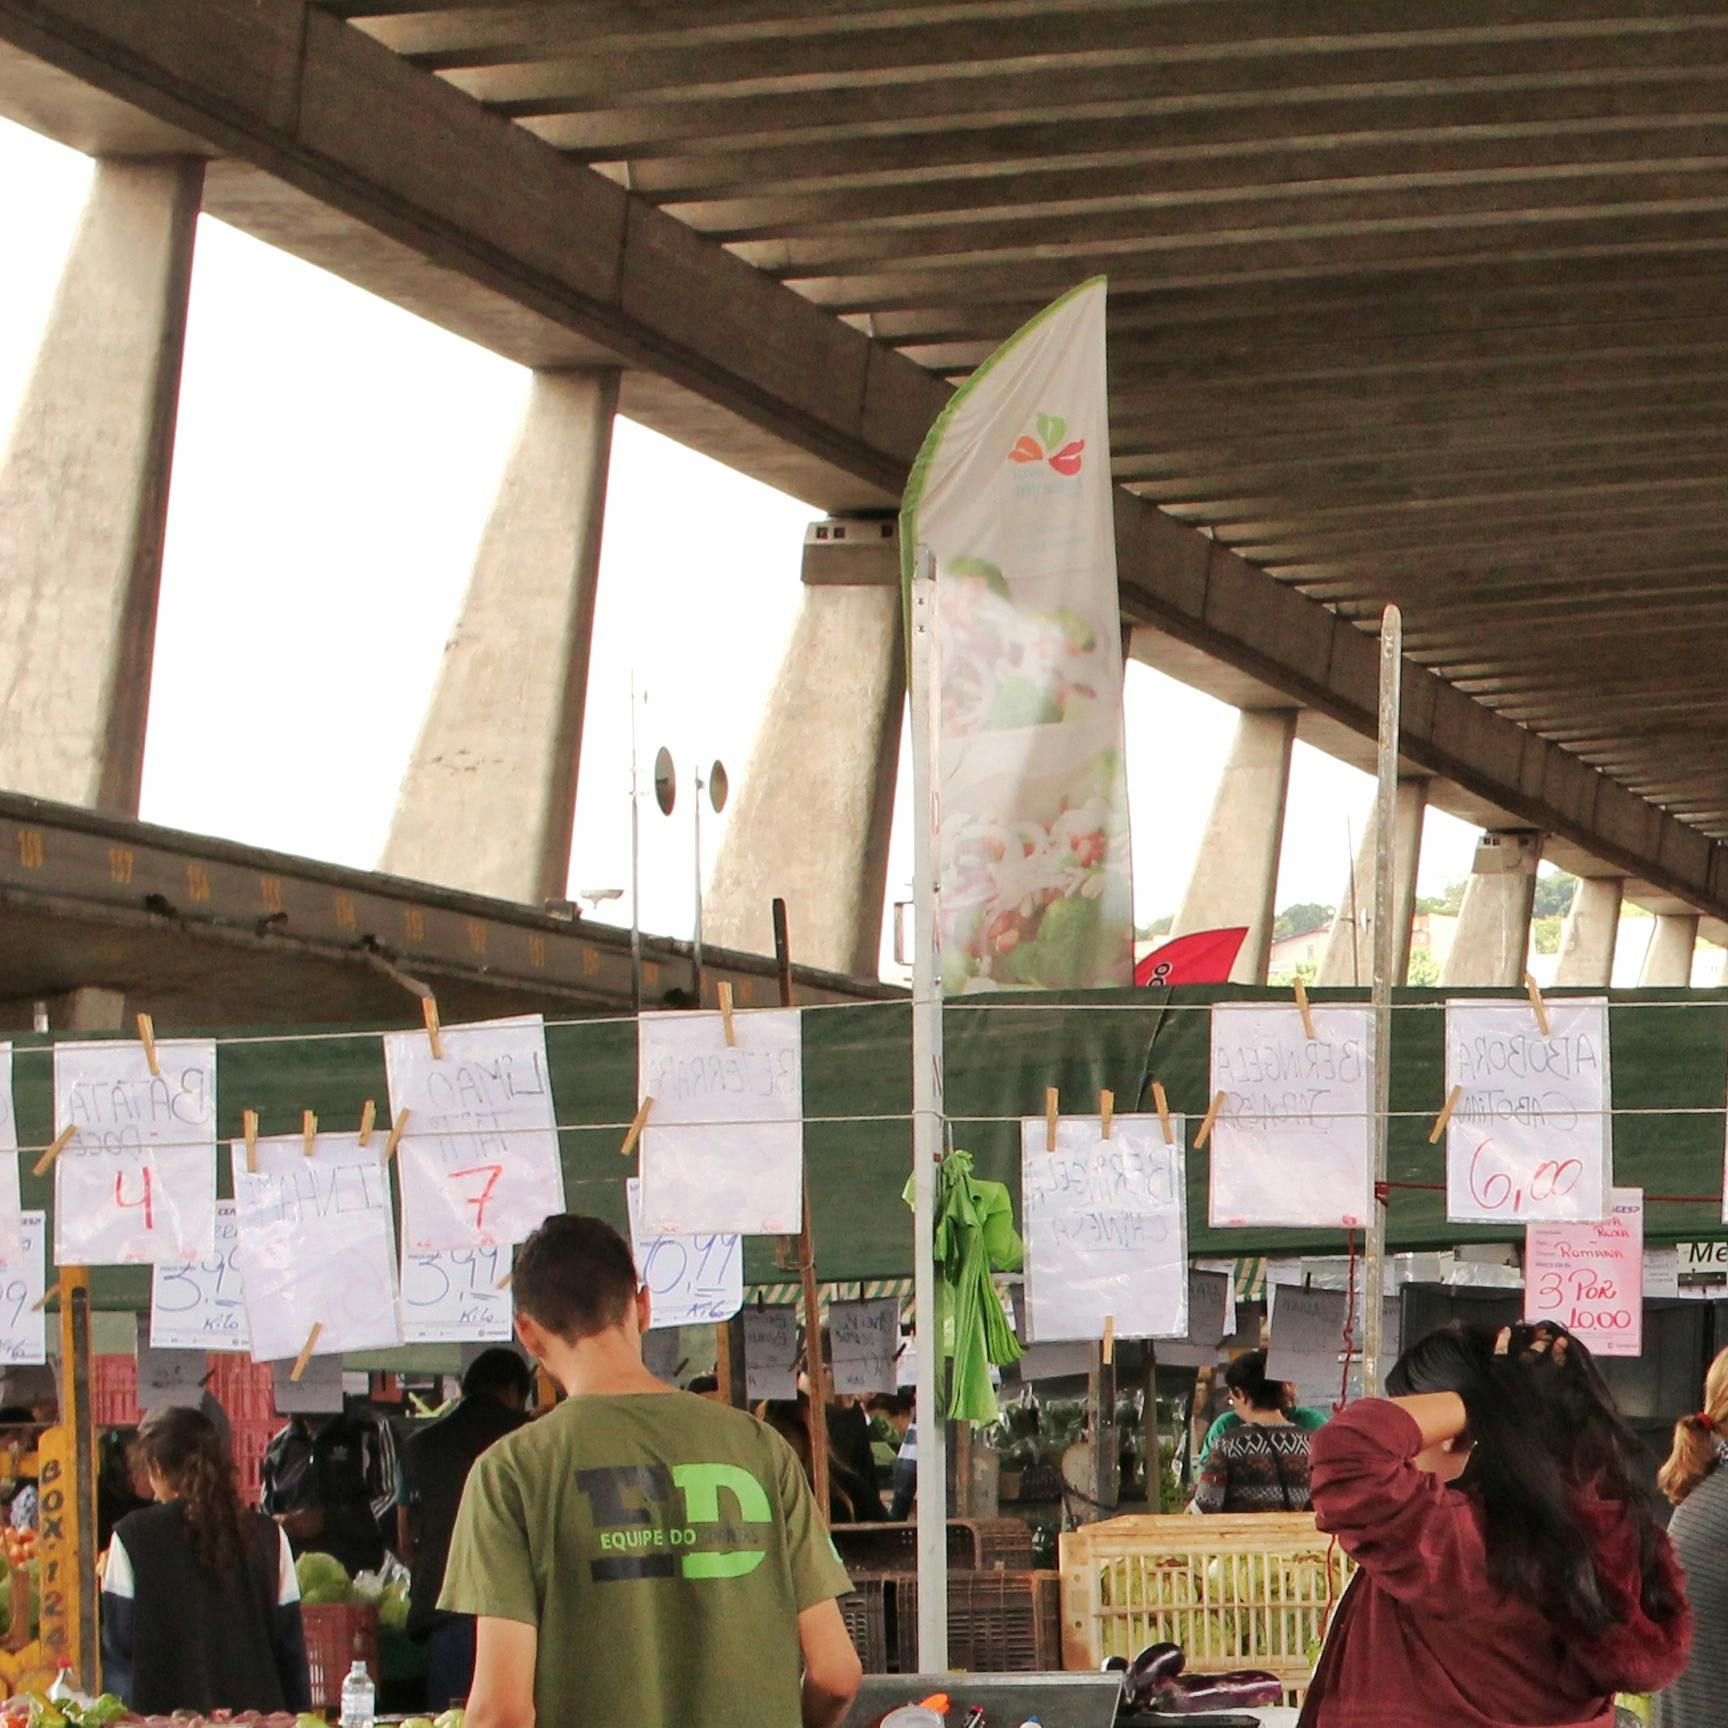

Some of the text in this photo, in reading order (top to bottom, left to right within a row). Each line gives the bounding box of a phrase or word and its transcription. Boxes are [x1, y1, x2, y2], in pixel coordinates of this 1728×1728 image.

[115, 1165, 154, 1230] 4
[449, 1164, 504, 1230] 7
[1468, 1137, 1585, 1213] 6,00
[1538, 1272, 1564, 1310] 3
[600, 1530, 664, 1551] EQUIPE
[669, 1529, 698, 1546] DO
